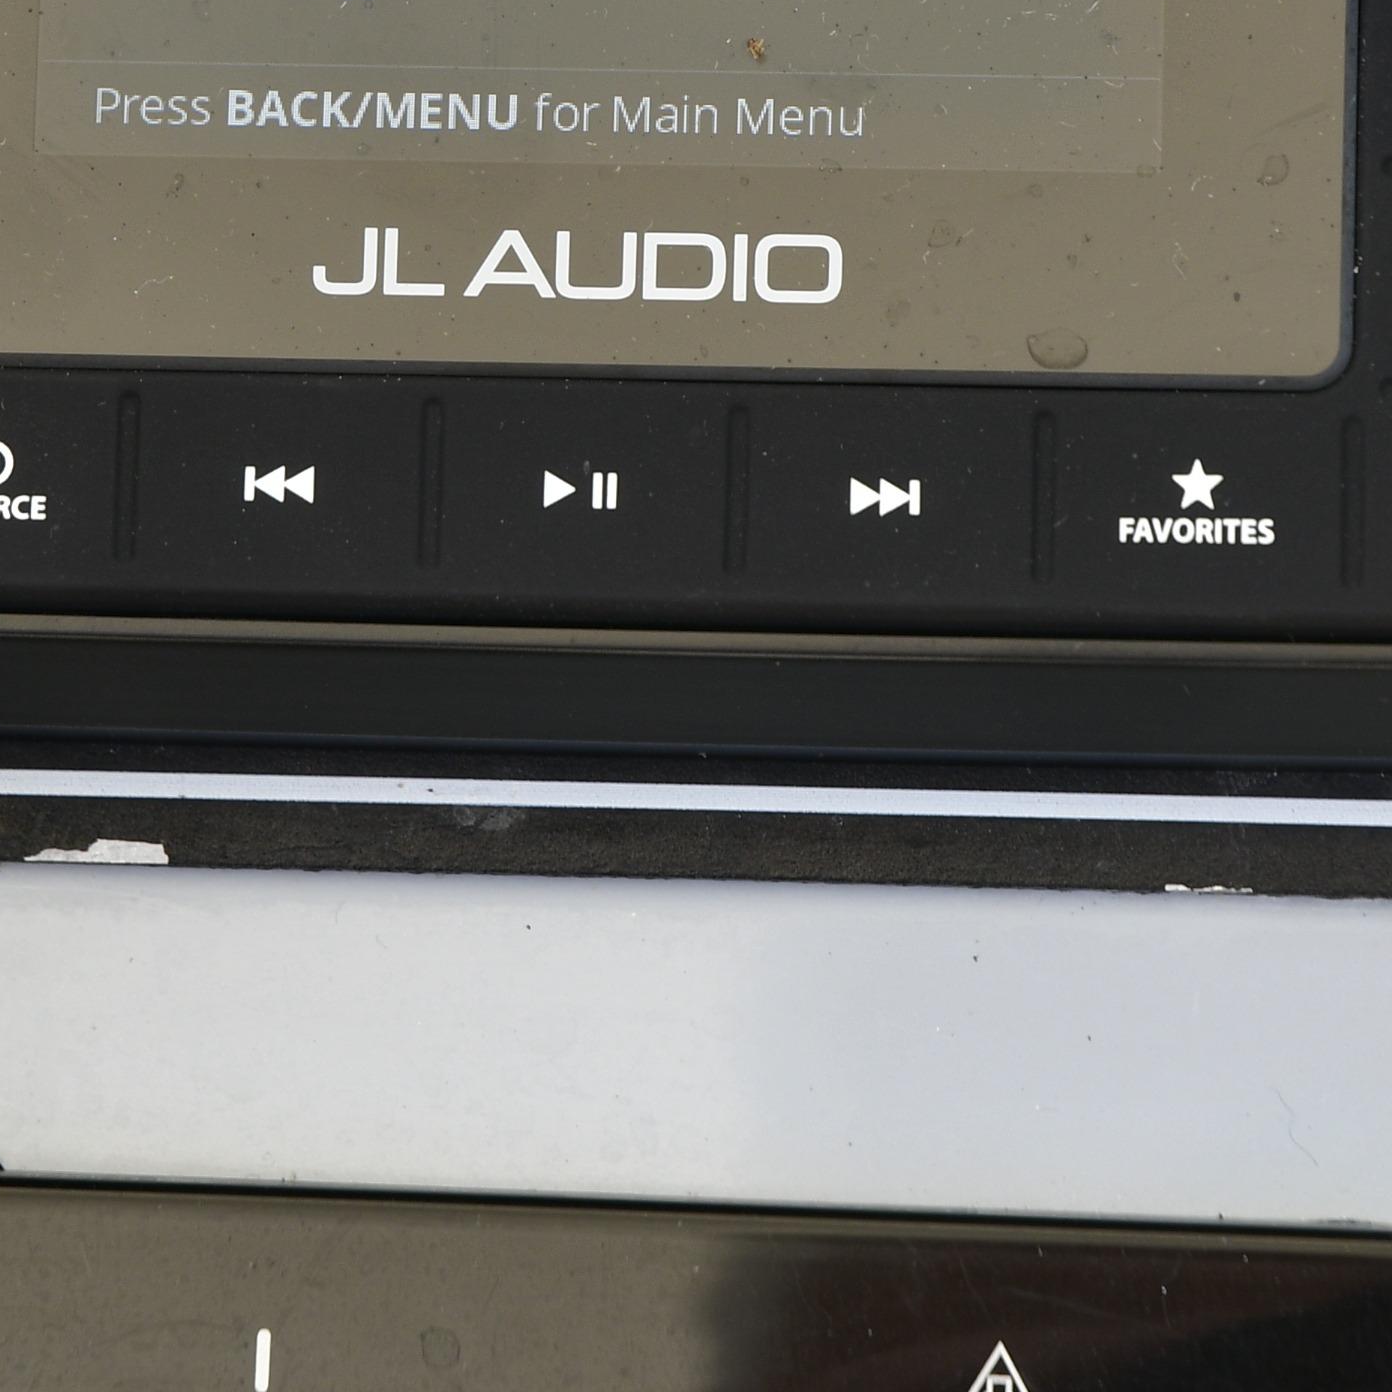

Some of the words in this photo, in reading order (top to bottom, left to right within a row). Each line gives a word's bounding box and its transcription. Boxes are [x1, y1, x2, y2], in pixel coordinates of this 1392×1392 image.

[94, 86, 211, 126] Press
[227, 88, 518, 131] BACK/MENU
[534, 91, 602, 133] for
[612, 95, 718, 135] Main
[735, 97, 864, 137] Menu
[312, 227, 445, 297] JL
[463, 229, 844, 304] AUDIO
[1118, 517, 1276, 546] FAVORITES
